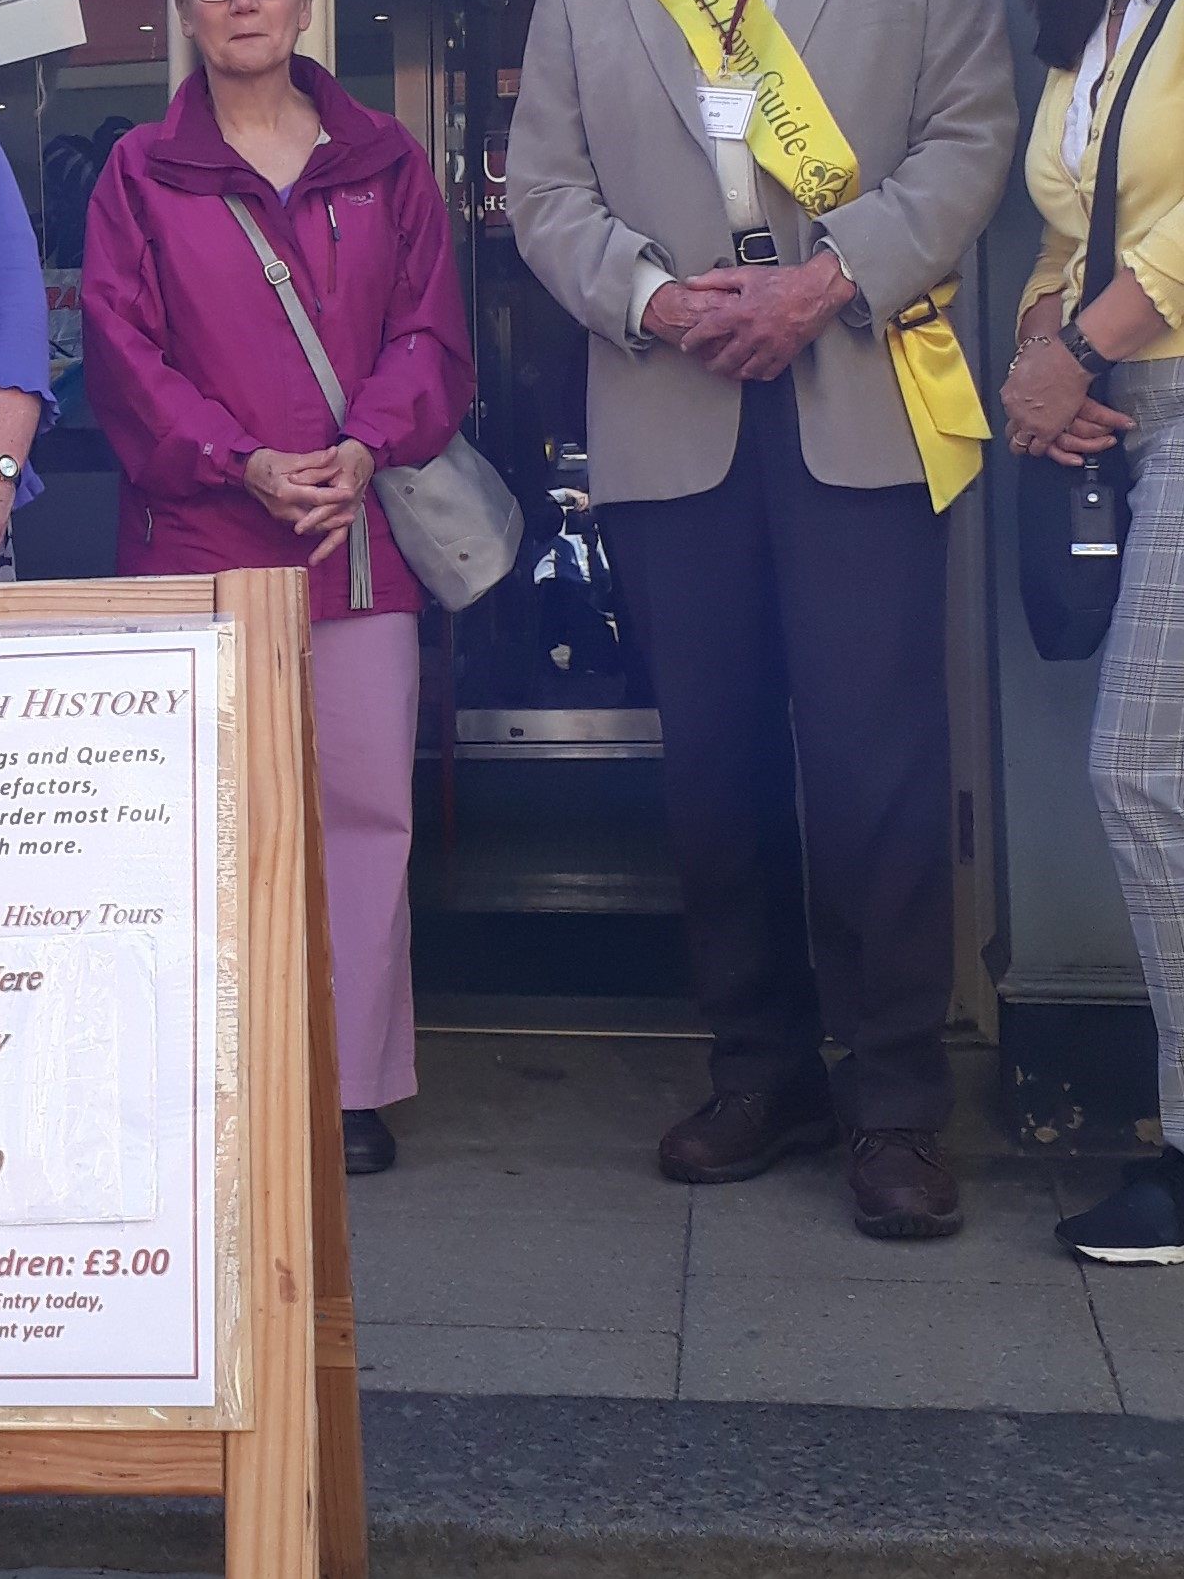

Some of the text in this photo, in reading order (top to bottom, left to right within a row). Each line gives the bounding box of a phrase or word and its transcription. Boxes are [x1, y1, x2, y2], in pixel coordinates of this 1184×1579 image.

[753, 70, 811, 157] Guide
[18, 686, 190, 720] HISTORY
[26, 745, 69, 766] and
[76, 744, 167, 767] Queens,
[53, 805, 110, 825] most
[116, 802, 172, 825] Foul,
[18, 837, 84, 856] more.
[1, 904, 91, 932] History
[97, 902, 164, 926] Tours
[82, 1248, 171, 1277] £3.00
[45, 1290, 105, 1314] today,
[21, 1324, 65, 1342] year
